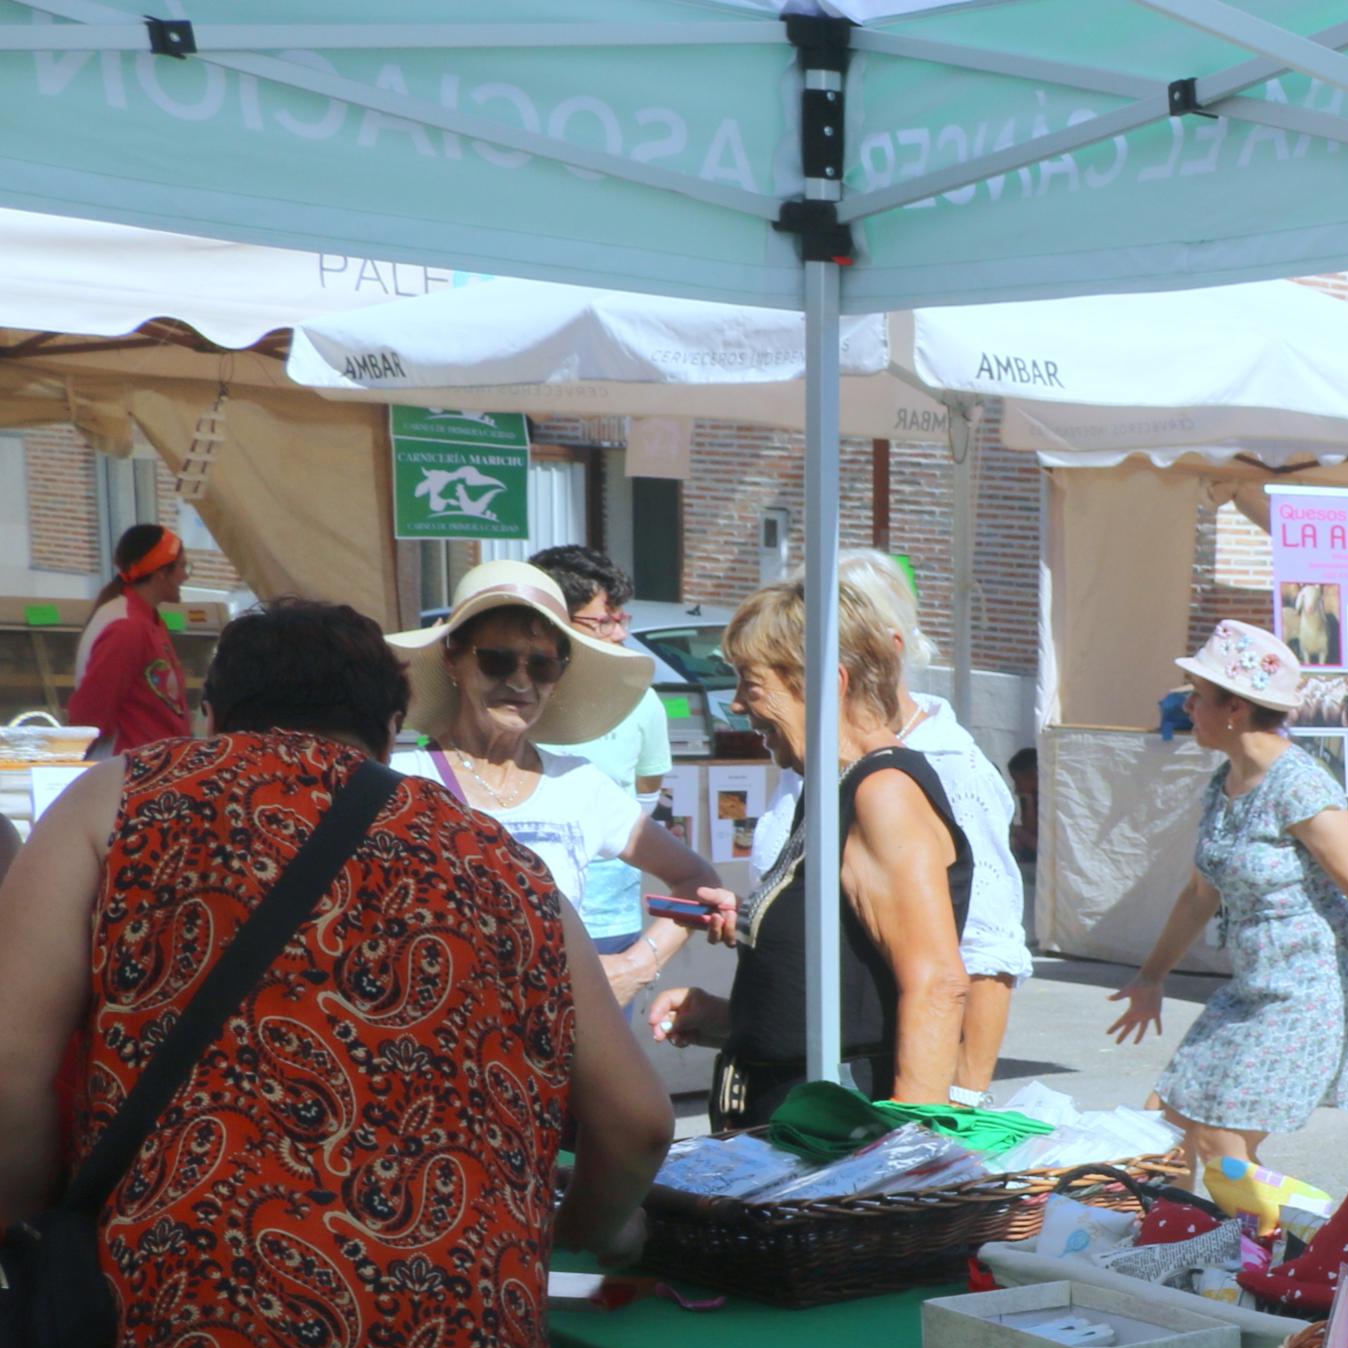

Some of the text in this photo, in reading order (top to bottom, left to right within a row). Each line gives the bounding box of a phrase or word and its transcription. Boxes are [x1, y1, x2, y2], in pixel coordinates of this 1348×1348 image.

[342, 351, 407, 380] AMBAR
[975, 352, 1066, 389] AMBAR
[1279, 503, 1348, 522] Quesos
[1281, 523, 1318, 549] LA
